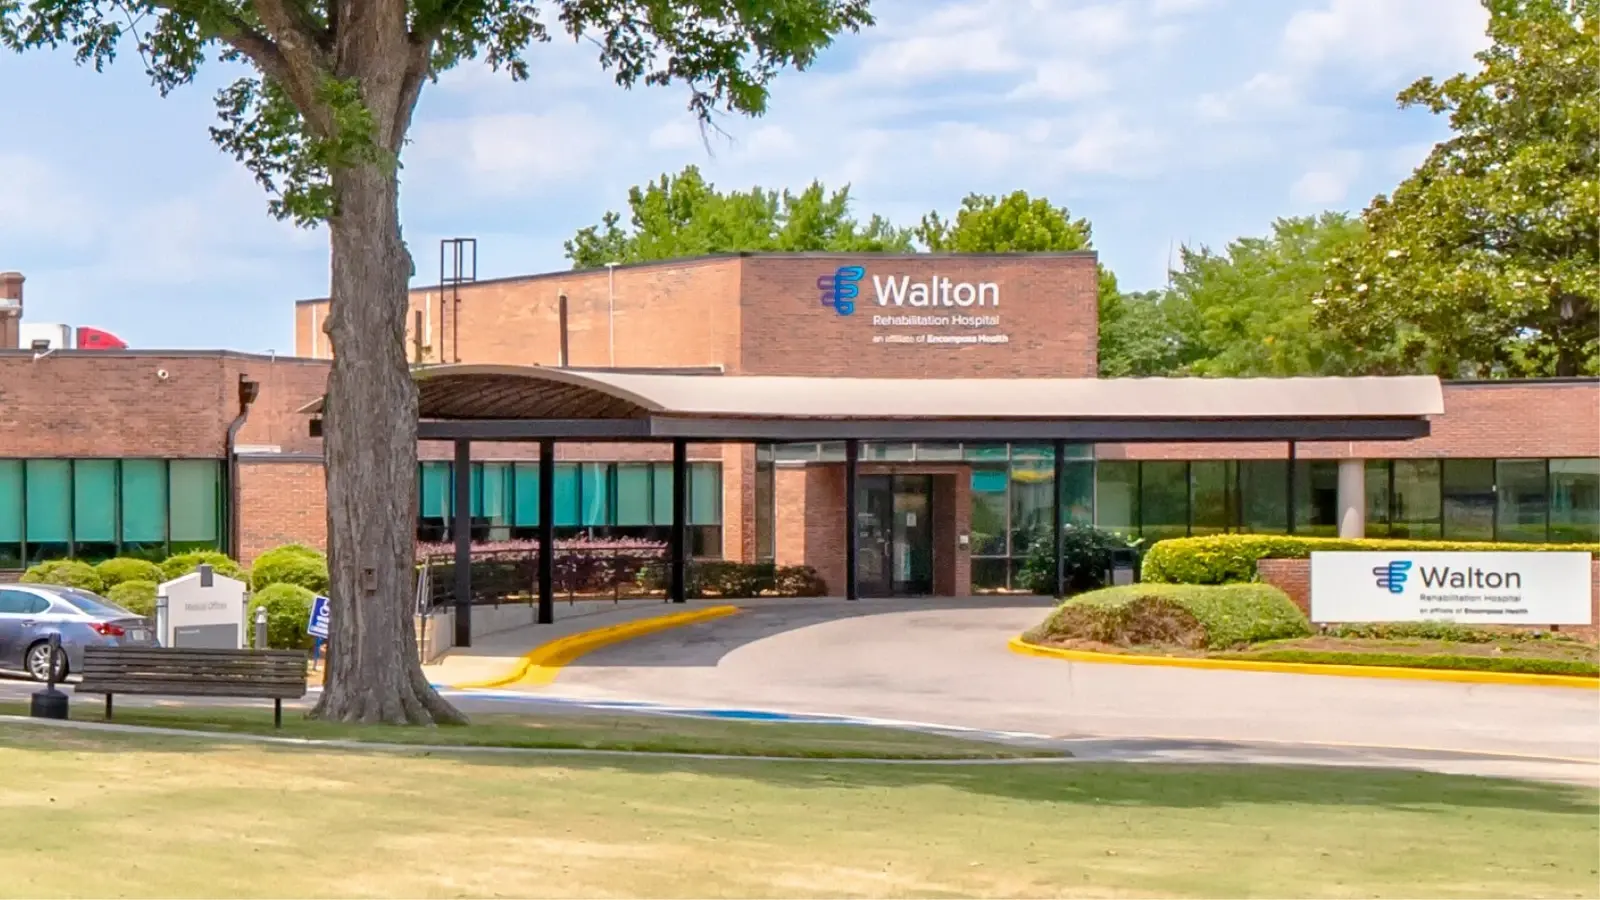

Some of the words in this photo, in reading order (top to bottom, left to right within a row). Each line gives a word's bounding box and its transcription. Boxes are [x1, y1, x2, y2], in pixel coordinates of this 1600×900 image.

[872, 275, 999, 307] Walton
[873, 315, 949, 326] Rehabilitation
[951, 315, 1000, 328] Hospital
[872, 335, 884, 343] an
[916, 334, 925, 343] of
[926, 334, 977, 344] Encompass
[977, 333, 1009, 343] Health
[1419, 566, 1521, 589] Walton
[1419, 593, 1482, 602] Rehabilitation
[1484, 595, 1521, 604] Hospital
